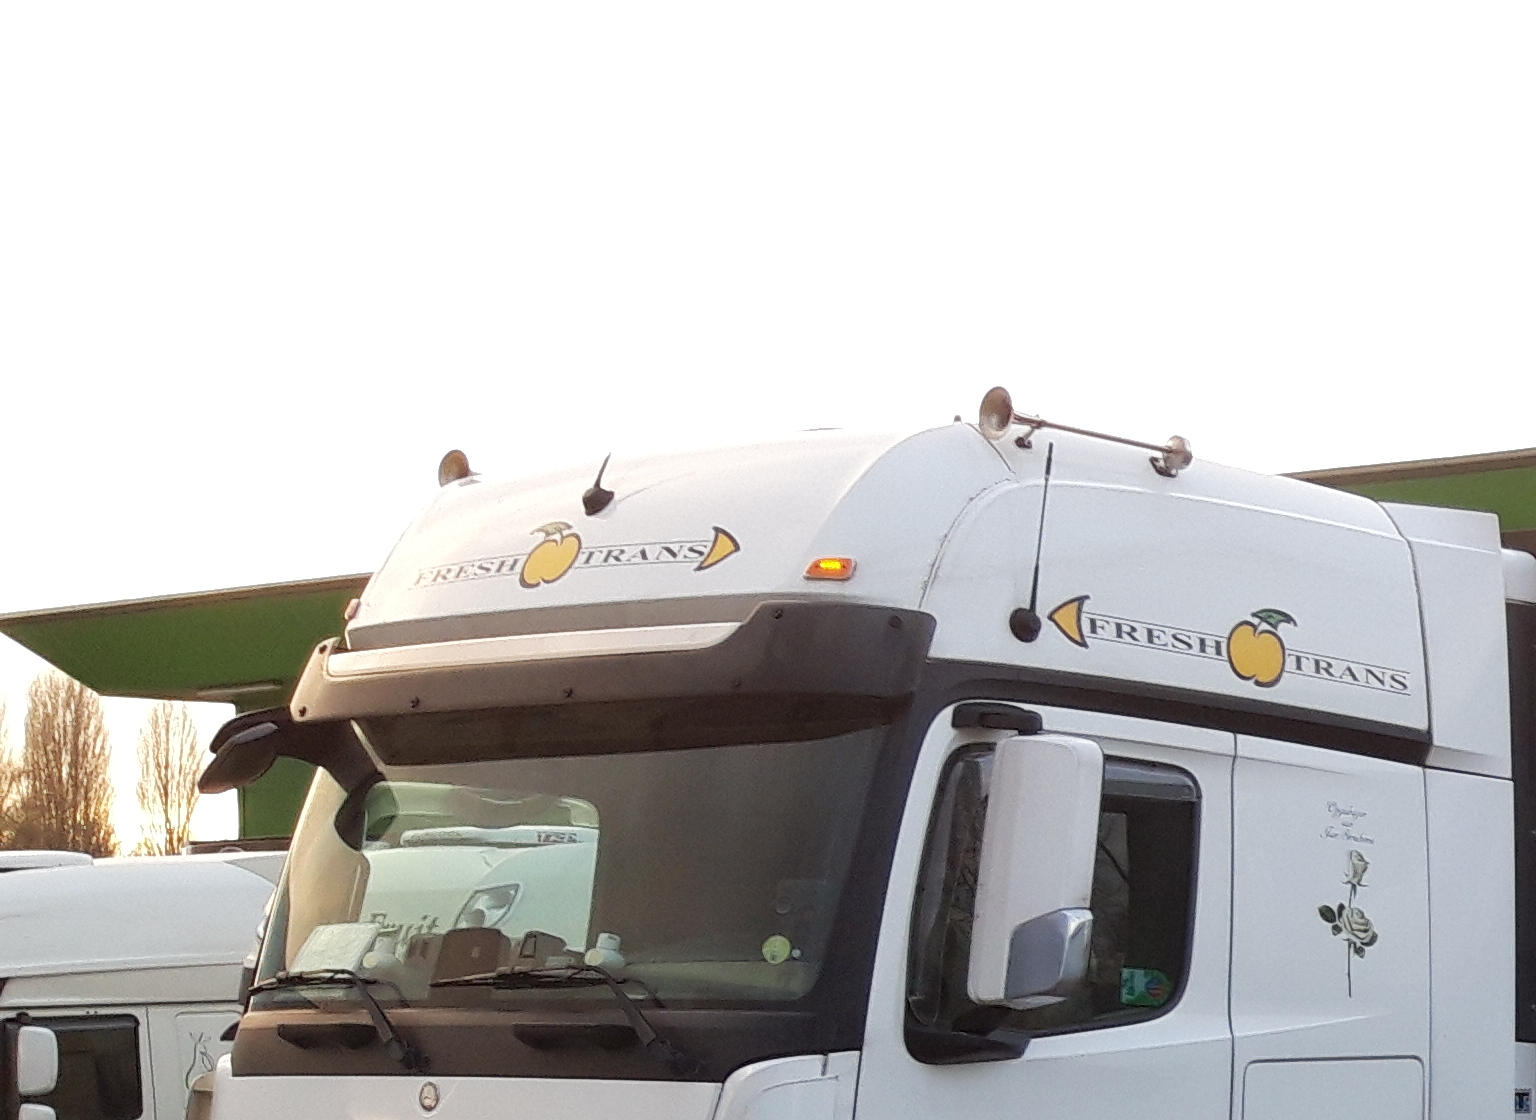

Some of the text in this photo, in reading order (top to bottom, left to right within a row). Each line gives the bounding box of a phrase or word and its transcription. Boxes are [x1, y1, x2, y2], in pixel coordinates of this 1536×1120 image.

[413, 544, 708, 587] FRESH TRANS
[1085, 616, 1409, 691] FRESH TRANS
